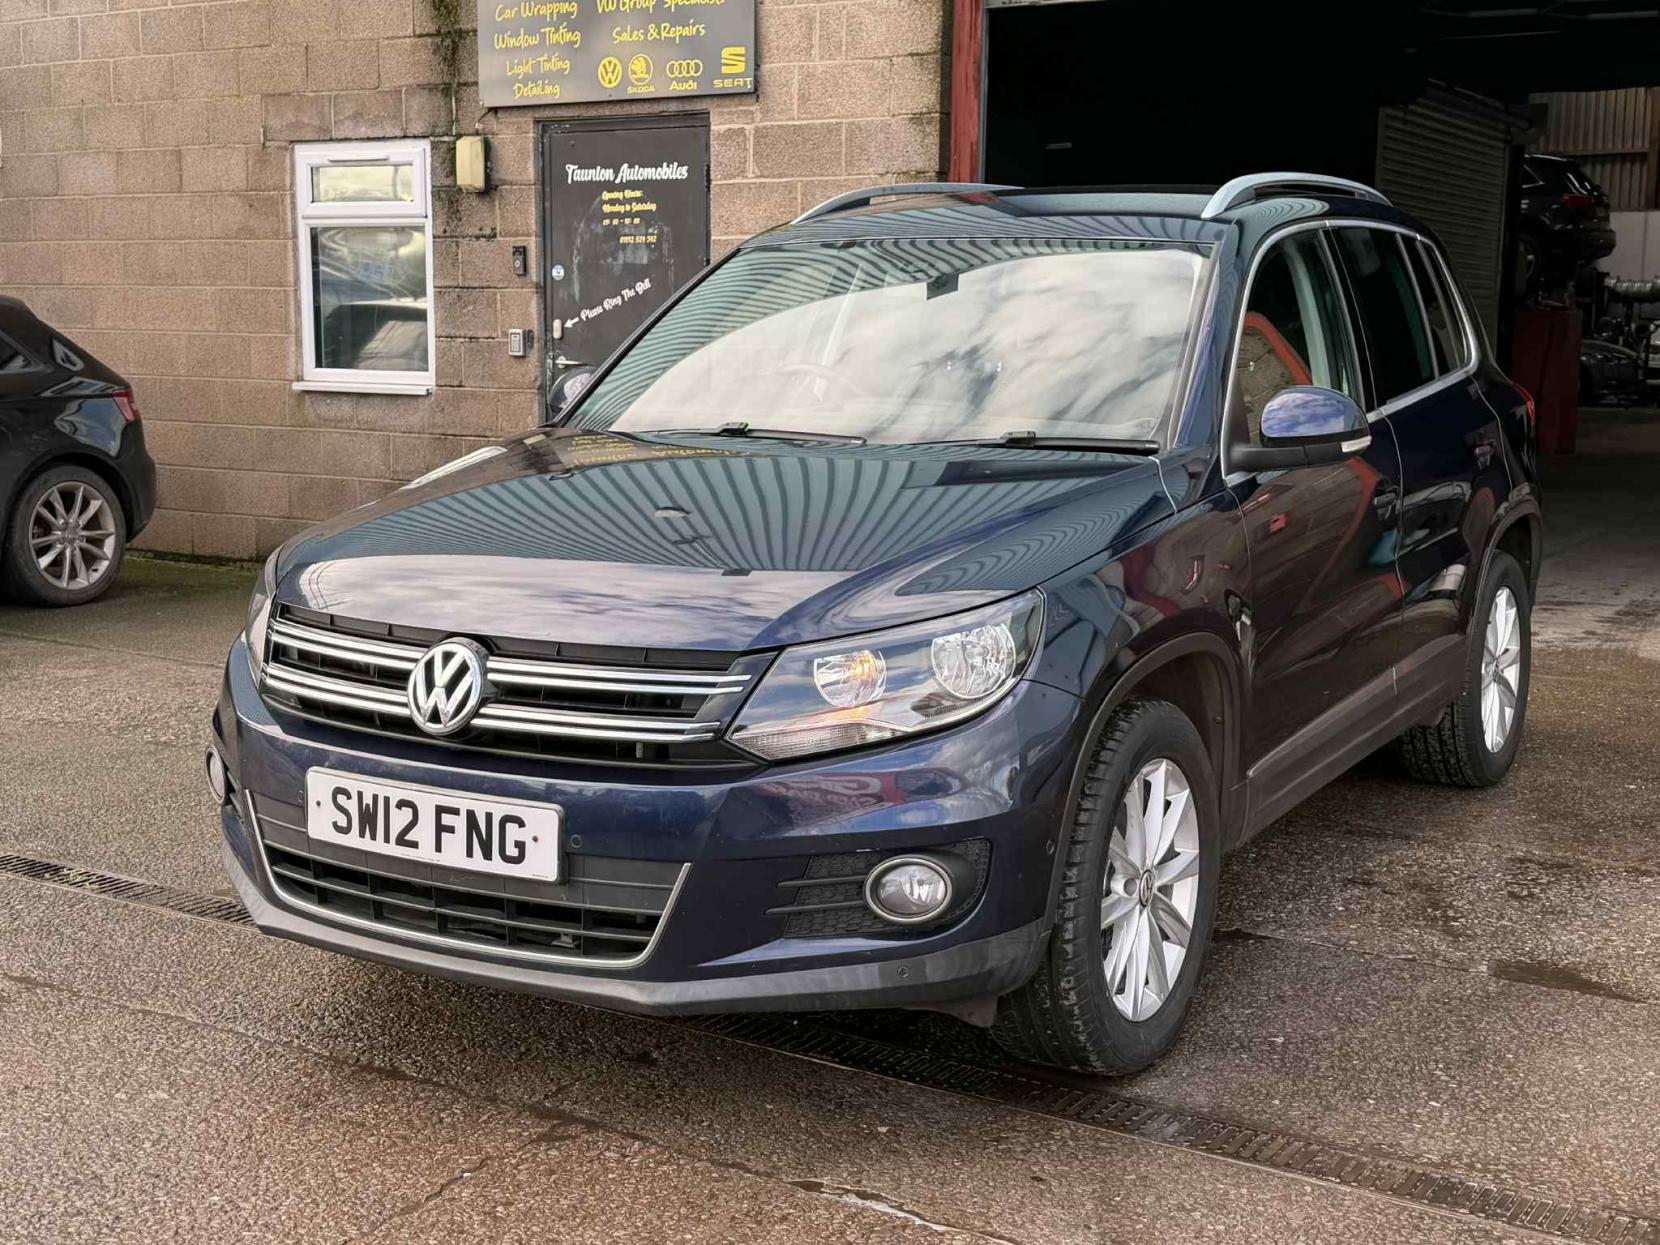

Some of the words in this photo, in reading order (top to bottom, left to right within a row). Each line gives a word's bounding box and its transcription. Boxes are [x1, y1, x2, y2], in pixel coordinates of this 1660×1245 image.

[495, 4, 518, 21] Car
[520, 1, 577, 22] Wrapping
[619, 0, 656, 13] Group
[494, 27, 539, 49] Window
[540, 22, 581, 48] Tinting
[612, 24, 644, 44] Sales
[661, 18, 706, 44] Repairs
[506, 57, 536, 79] Light
[536, 52, 570, 74] Tinting
[669, 80, 698, 91] Audi
[713, 77, 752, 88] SEAT
[565, 163, 615, 184] Taunton
[615, 162, 689, 184] Automobiles
[602, 203, 625, 214] Monday
[631, 202, 657, 212] Saturday
[580, 305, 603, 321] Please
[603, 295, 622, 311] Ring
[621, 288, 636, 301] The
[635, 277, 652, 294] Bell
[331, 786, 419, 850] SW12
[434, 803, 527, 865] FNG
